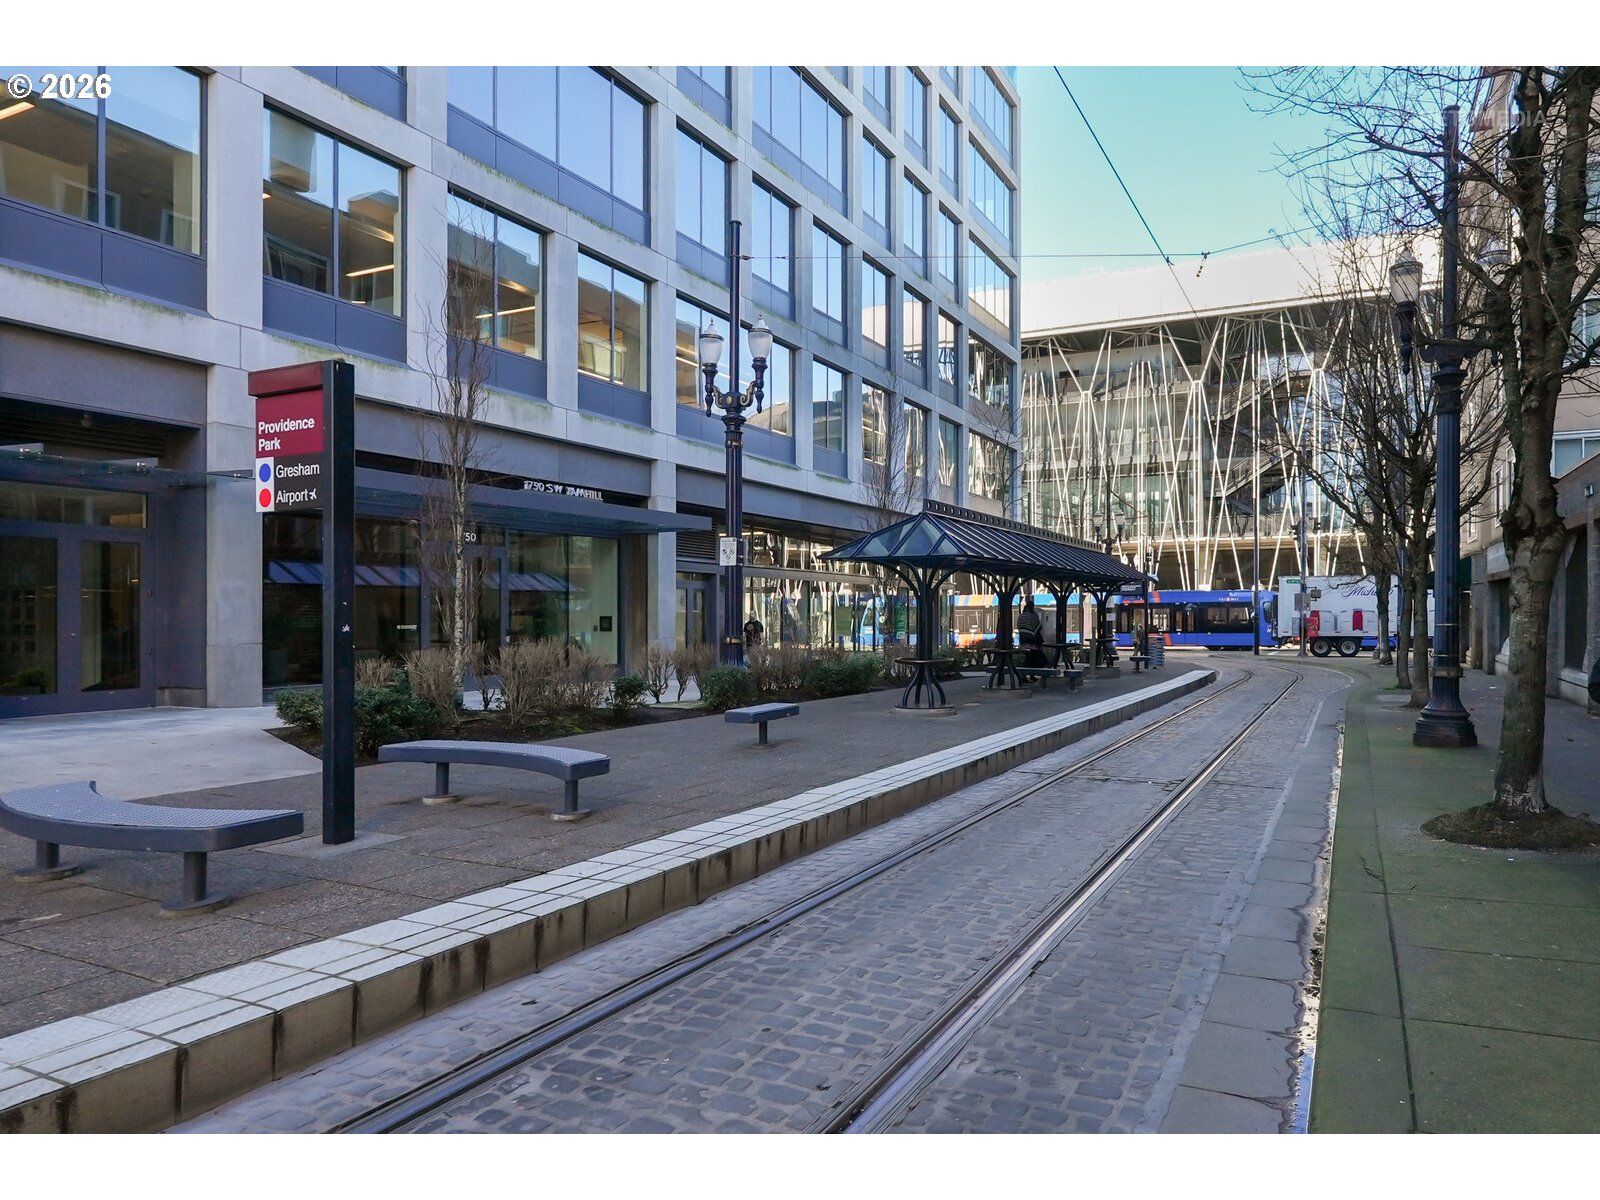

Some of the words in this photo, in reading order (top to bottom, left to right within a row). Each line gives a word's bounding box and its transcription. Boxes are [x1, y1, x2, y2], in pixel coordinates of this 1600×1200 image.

[258, 417, 315, 434] Providence
[258, 437, 281, 451] Park
[276, 463, 320, 478] Gresham
[545, 483, 564, 494] SW
[275, 490, 308, 506] Airport
